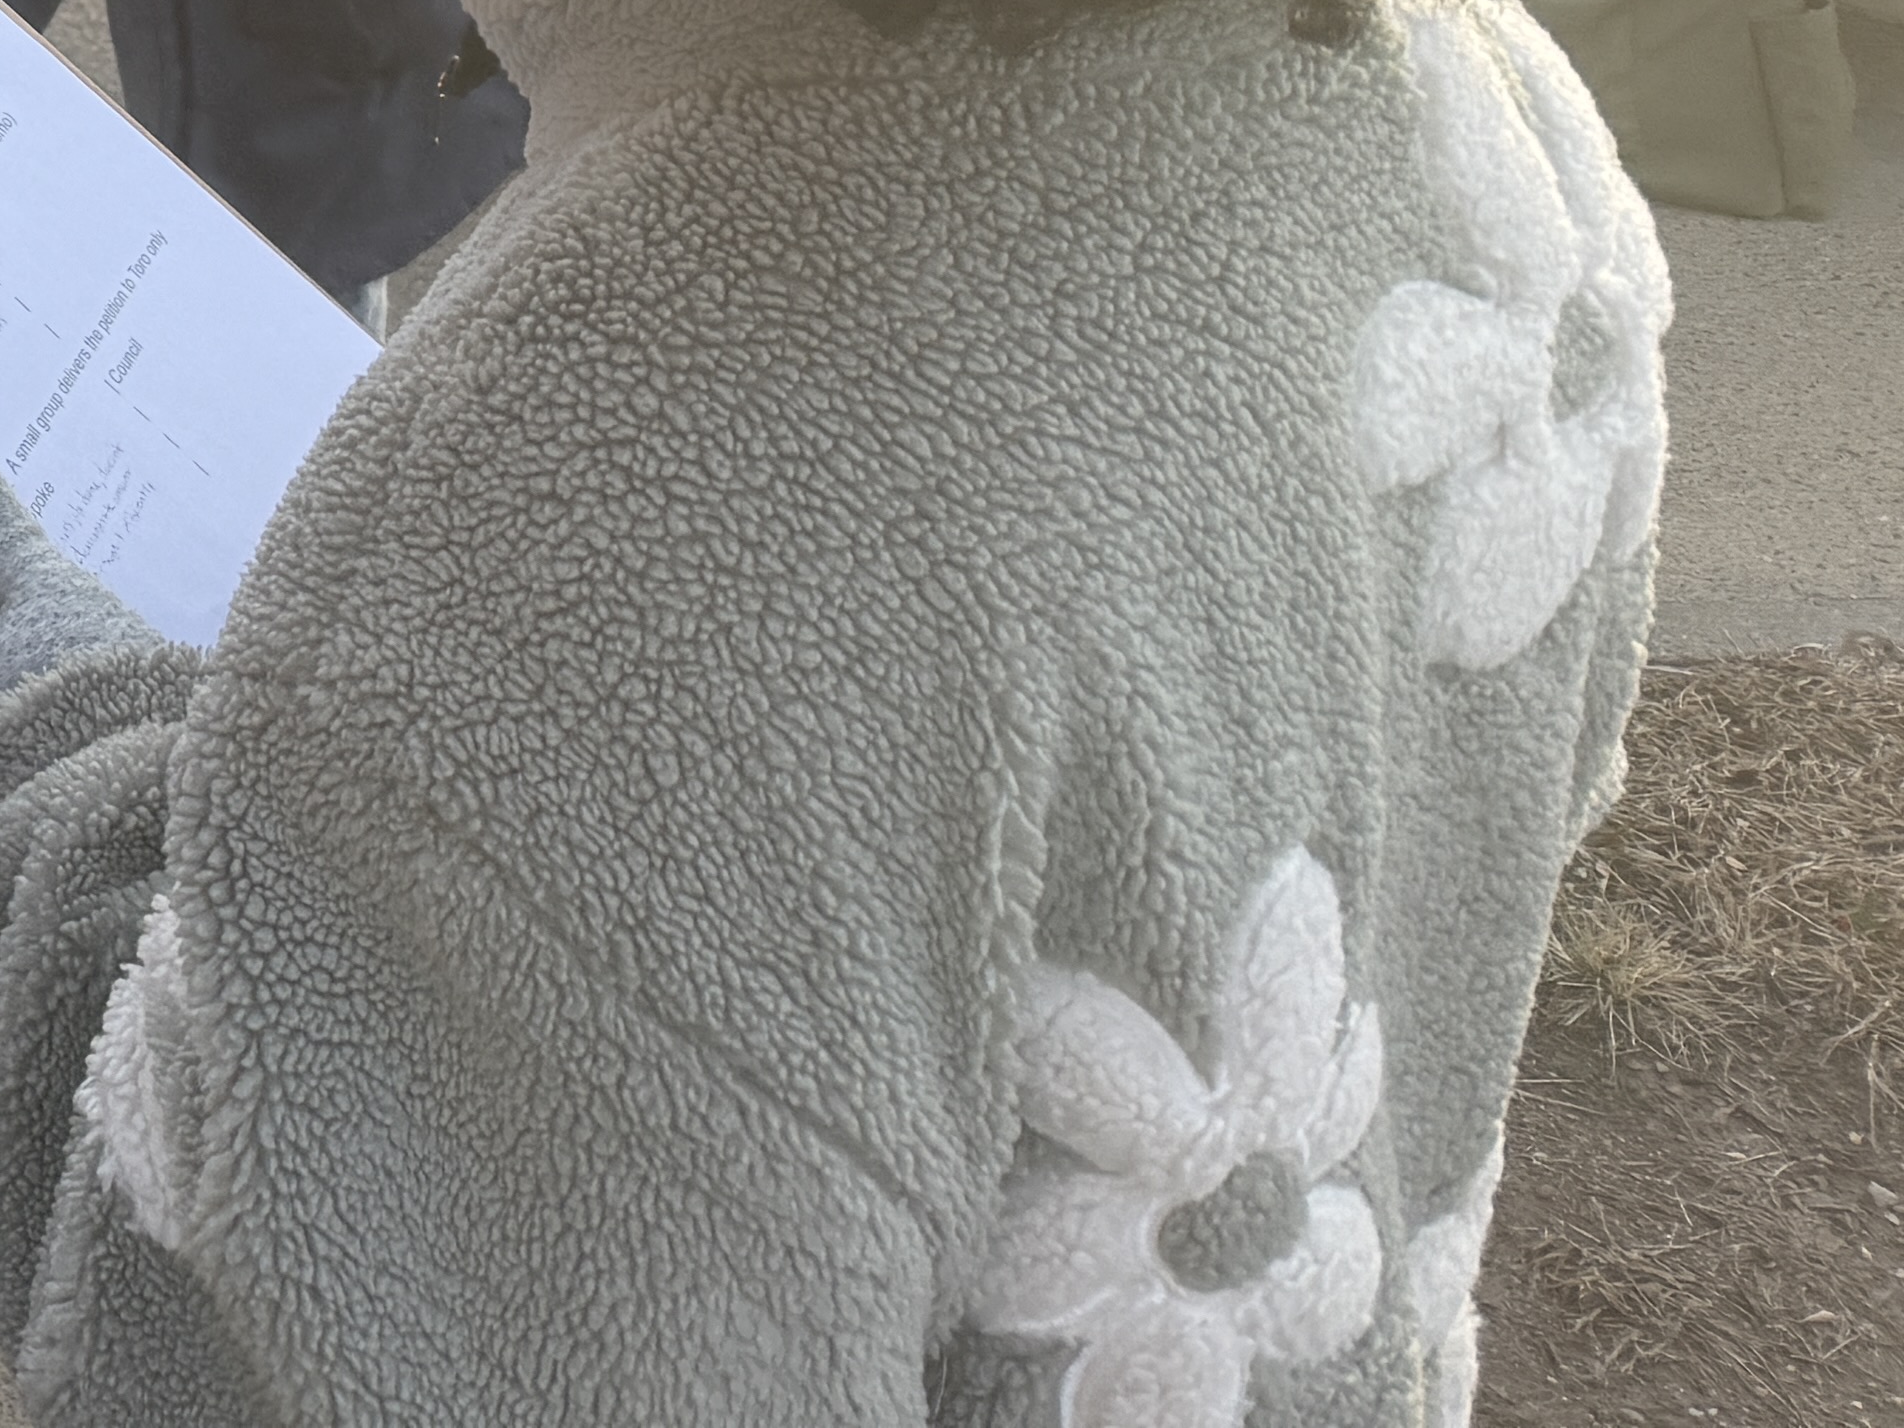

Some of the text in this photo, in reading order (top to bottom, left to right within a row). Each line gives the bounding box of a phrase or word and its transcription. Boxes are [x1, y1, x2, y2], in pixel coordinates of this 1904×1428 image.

[15, 423, 41, 462] small
[35, 392, 65, 433] group
[57, 348, 92, 395] delivers
[83, 329, 104, 352] the
[97, 290, 129, 336] petition
[126, 253, 152, 279] Toro
[146, 230, 169, 257] only
[108, 337, 143, 385] Council
